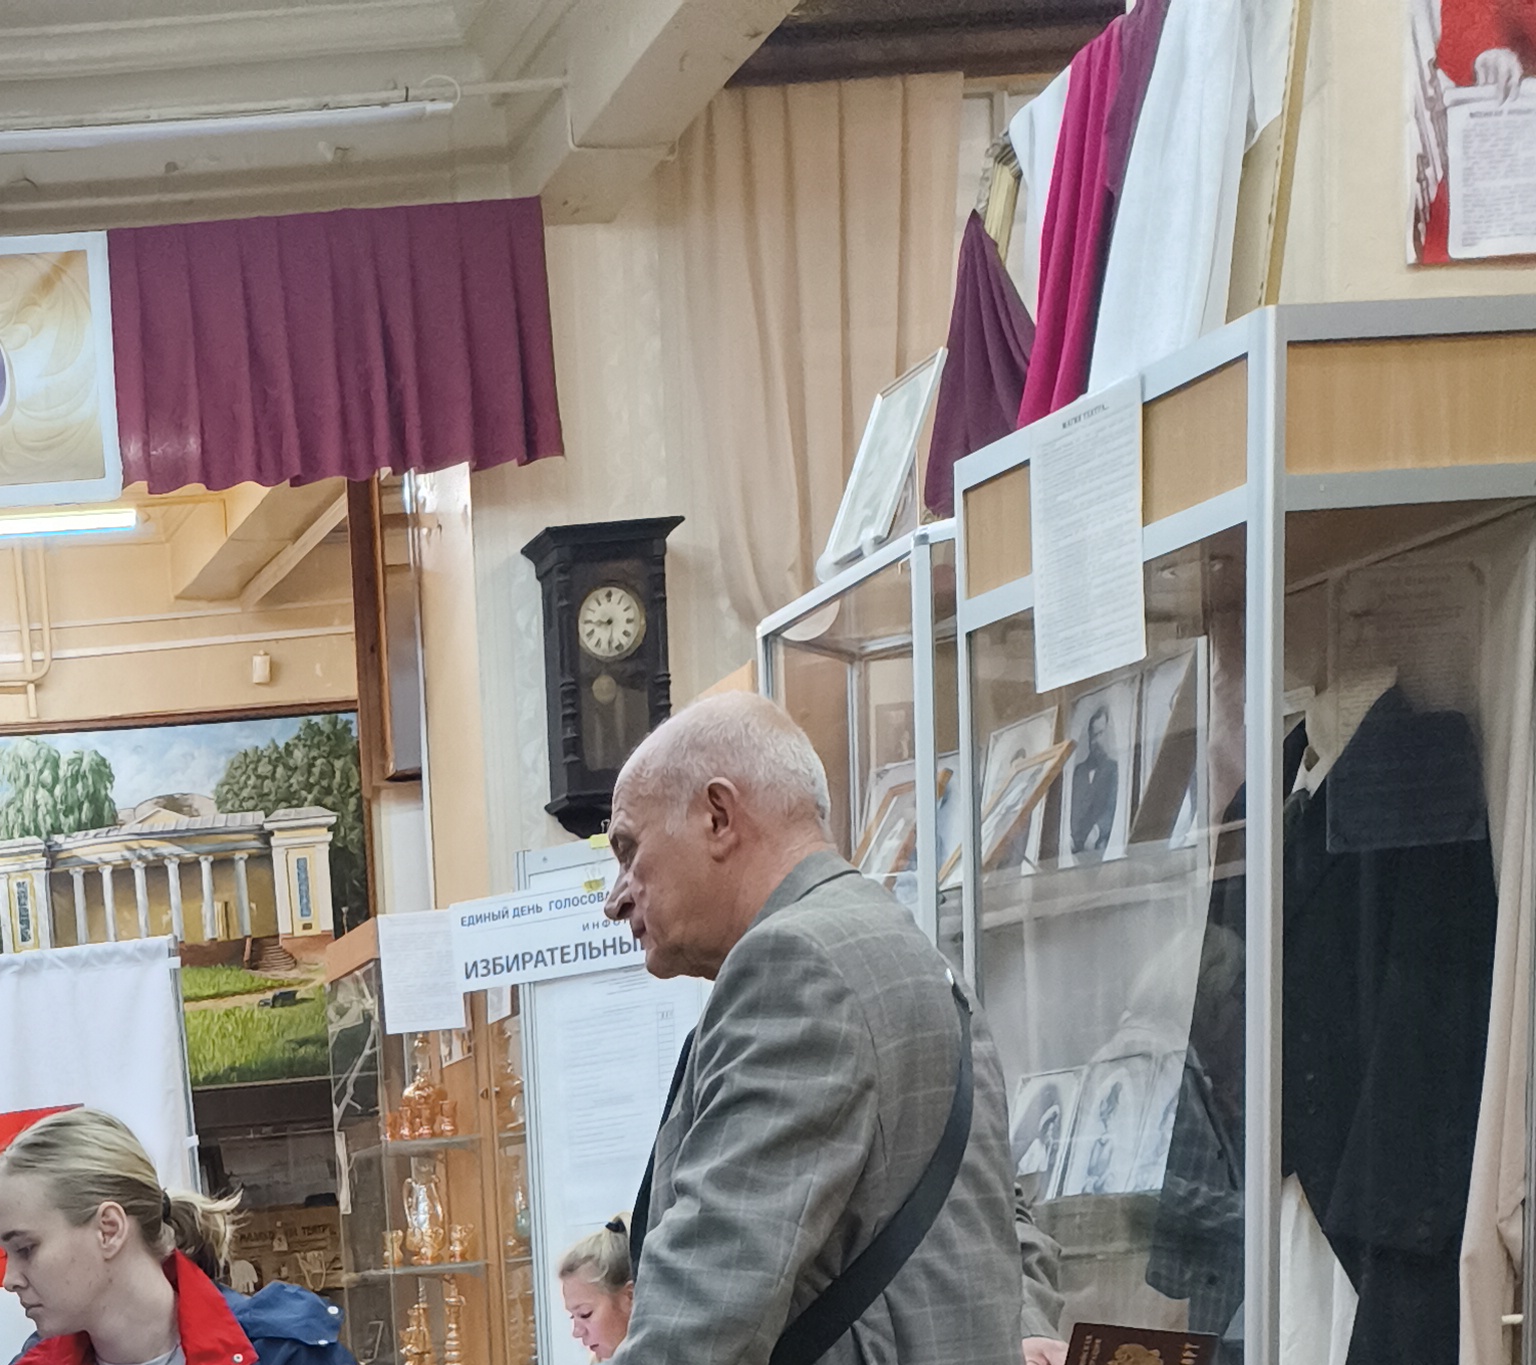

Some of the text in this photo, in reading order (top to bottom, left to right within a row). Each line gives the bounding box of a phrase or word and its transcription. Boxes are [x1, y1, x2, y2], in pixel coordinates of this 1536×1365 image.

[460, 906, 510, 928] ЕДИНЫЙ
[512, 902, 543, 919] ДЕНЬ
[464, 935, 645, 980] ИЗБИРАТЕЛЬНЫ
